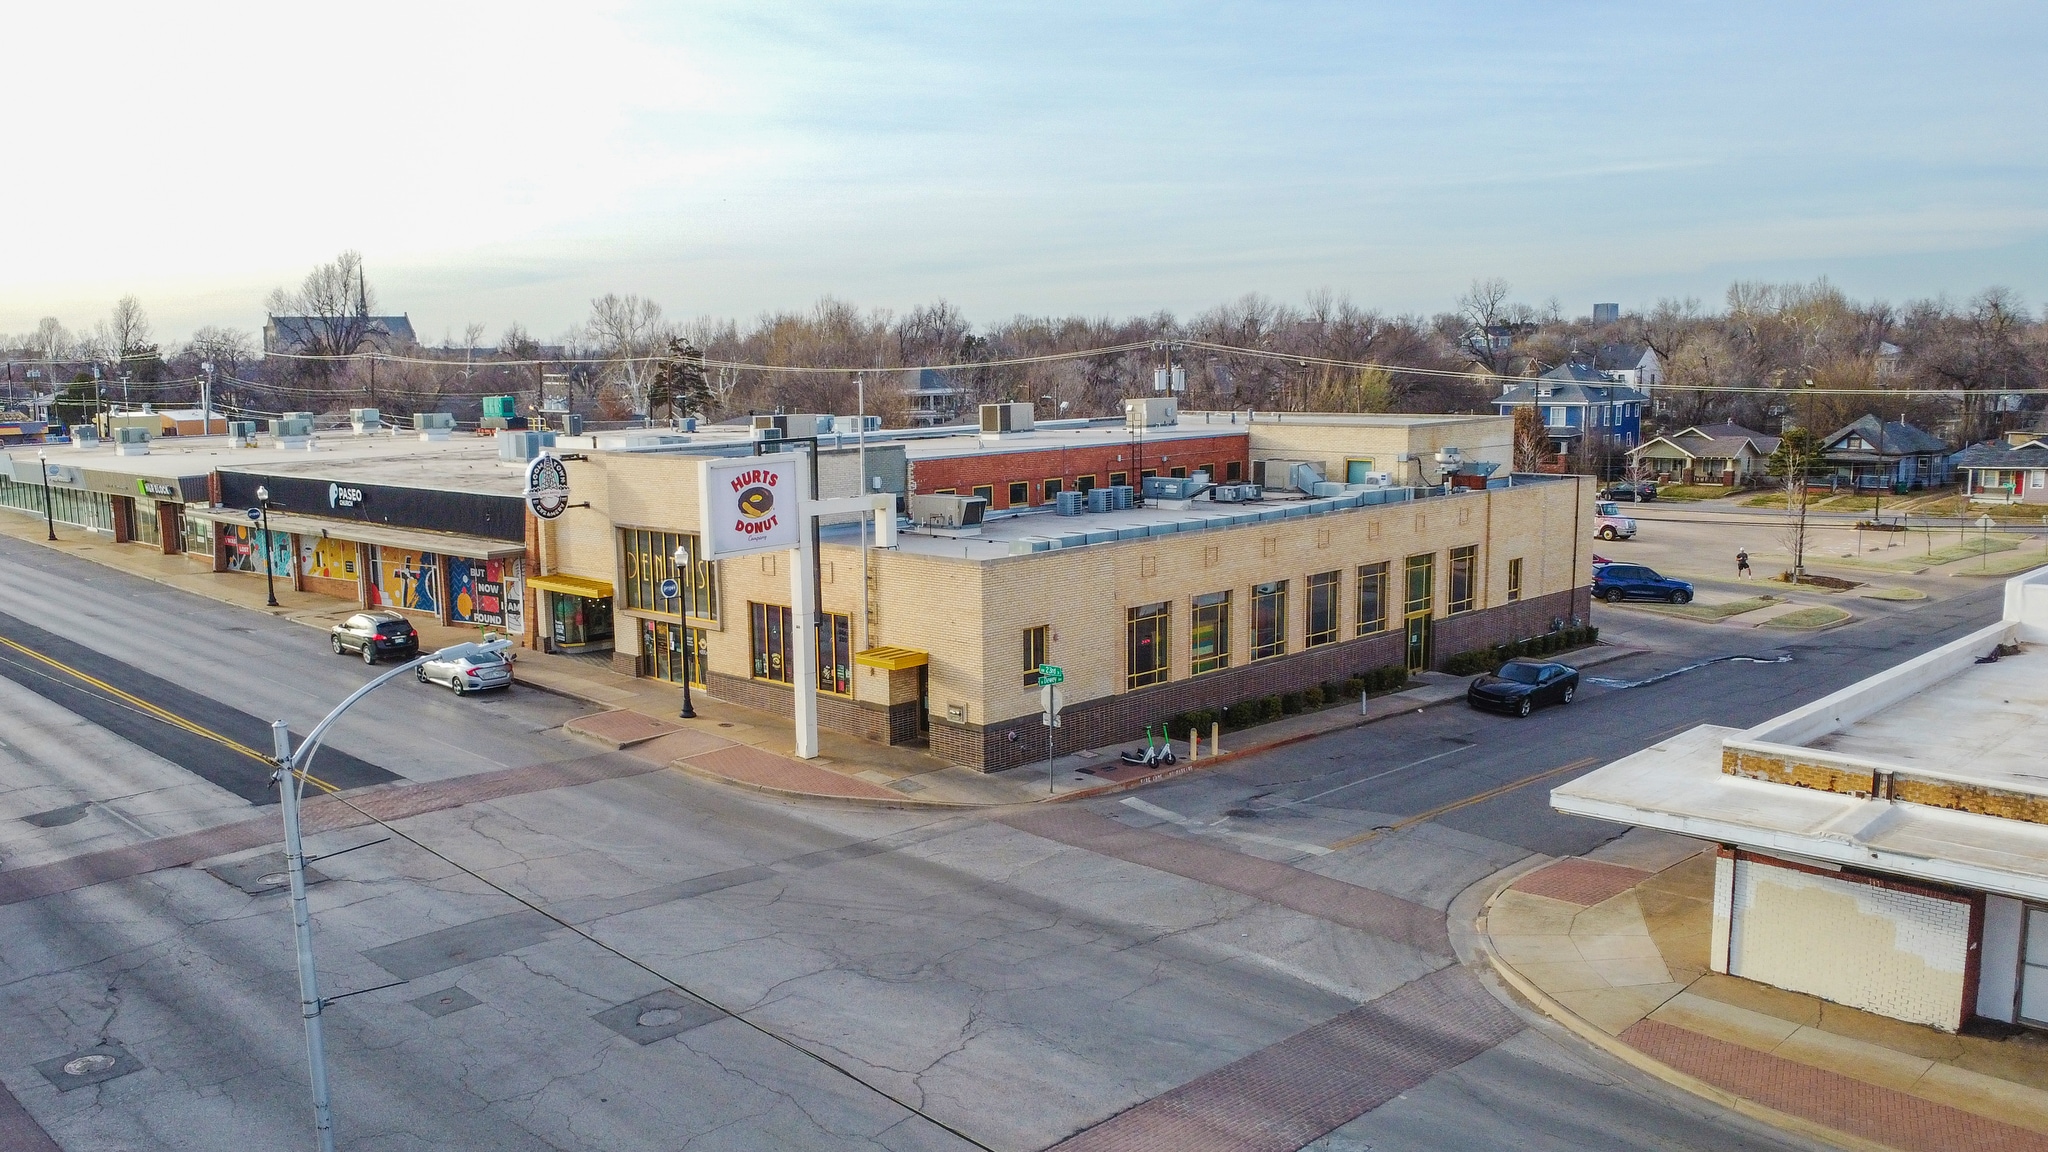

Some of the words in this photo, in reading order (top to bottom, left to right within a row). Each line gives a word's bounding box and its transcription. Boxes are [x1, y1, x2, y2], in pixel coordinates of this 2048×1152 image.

[730, 469, 779, 493] HURTS
[338, 487, 362, 502] PASEO
[735, 514, 779, 534] DONUT
[747, 534, 767, 542] Company
[470, 567, 486, 577] BUT
[627, 551, 715, 590] DENTIS
[478, 583, 499, 593] NOW
[508, 602, 520, 612] AM
[473, 613, 502, 625] FOUND
